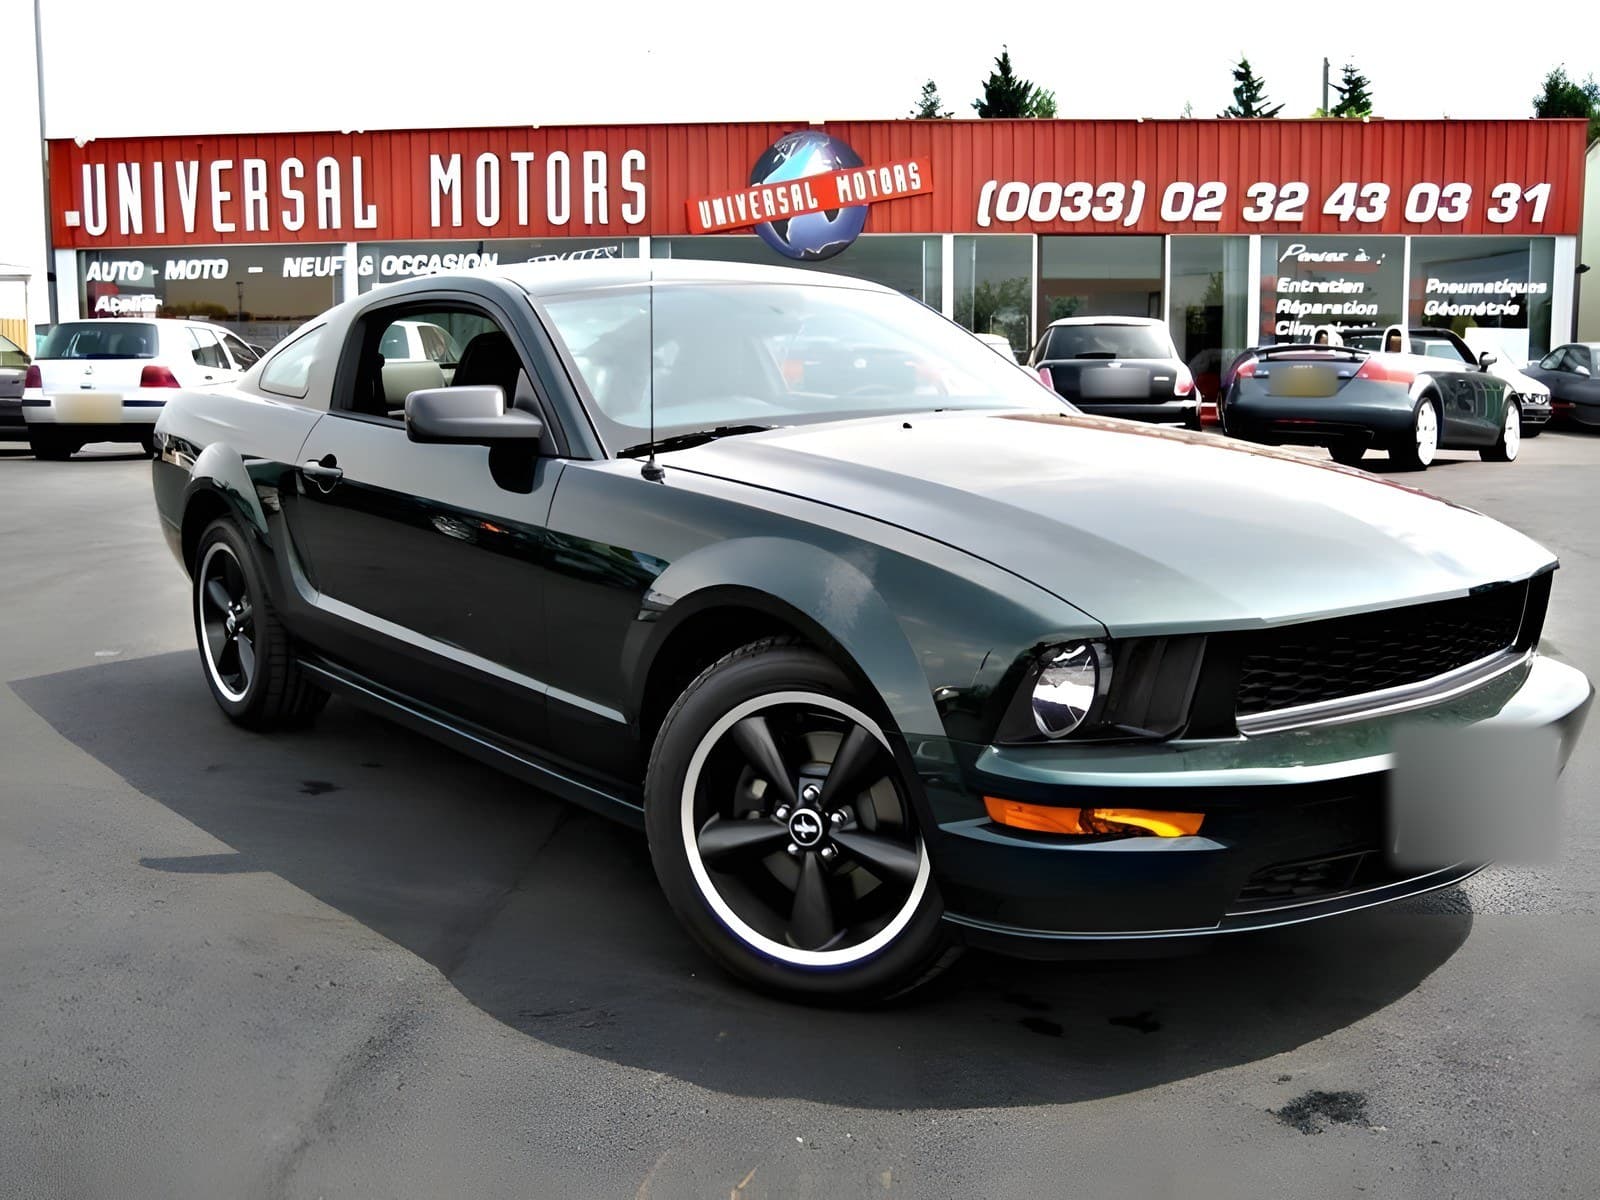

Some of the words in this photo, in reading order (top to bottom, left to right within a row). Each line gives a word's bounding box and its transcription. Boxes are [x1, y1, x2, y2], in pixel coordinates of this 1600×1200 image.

[81, 156, 378, 237] UNIVERSAL
[429, 149, 646, 228] MOTORS
[698, 181, 819, 229] UNIVERSAL
[836, 161, 922, 203] MOTORS
[976, 179, 1146, 227] (0033)
[1160, 181, 1228, 222] 02
[1242, 181, 1310, 222] 32
[1322, 182, 1391, 222] 43
[1404, 182, 1473, 223] 03
[1487, 182, 1552, 223] 31
[86, 260, 145, 282] AUTO
[164, 258, 229, 281] MOTO
[282, 255, 347, 278] NEUF
[358, 255, 374, 276] &
[381, 252, 499, 276] OCCASION
